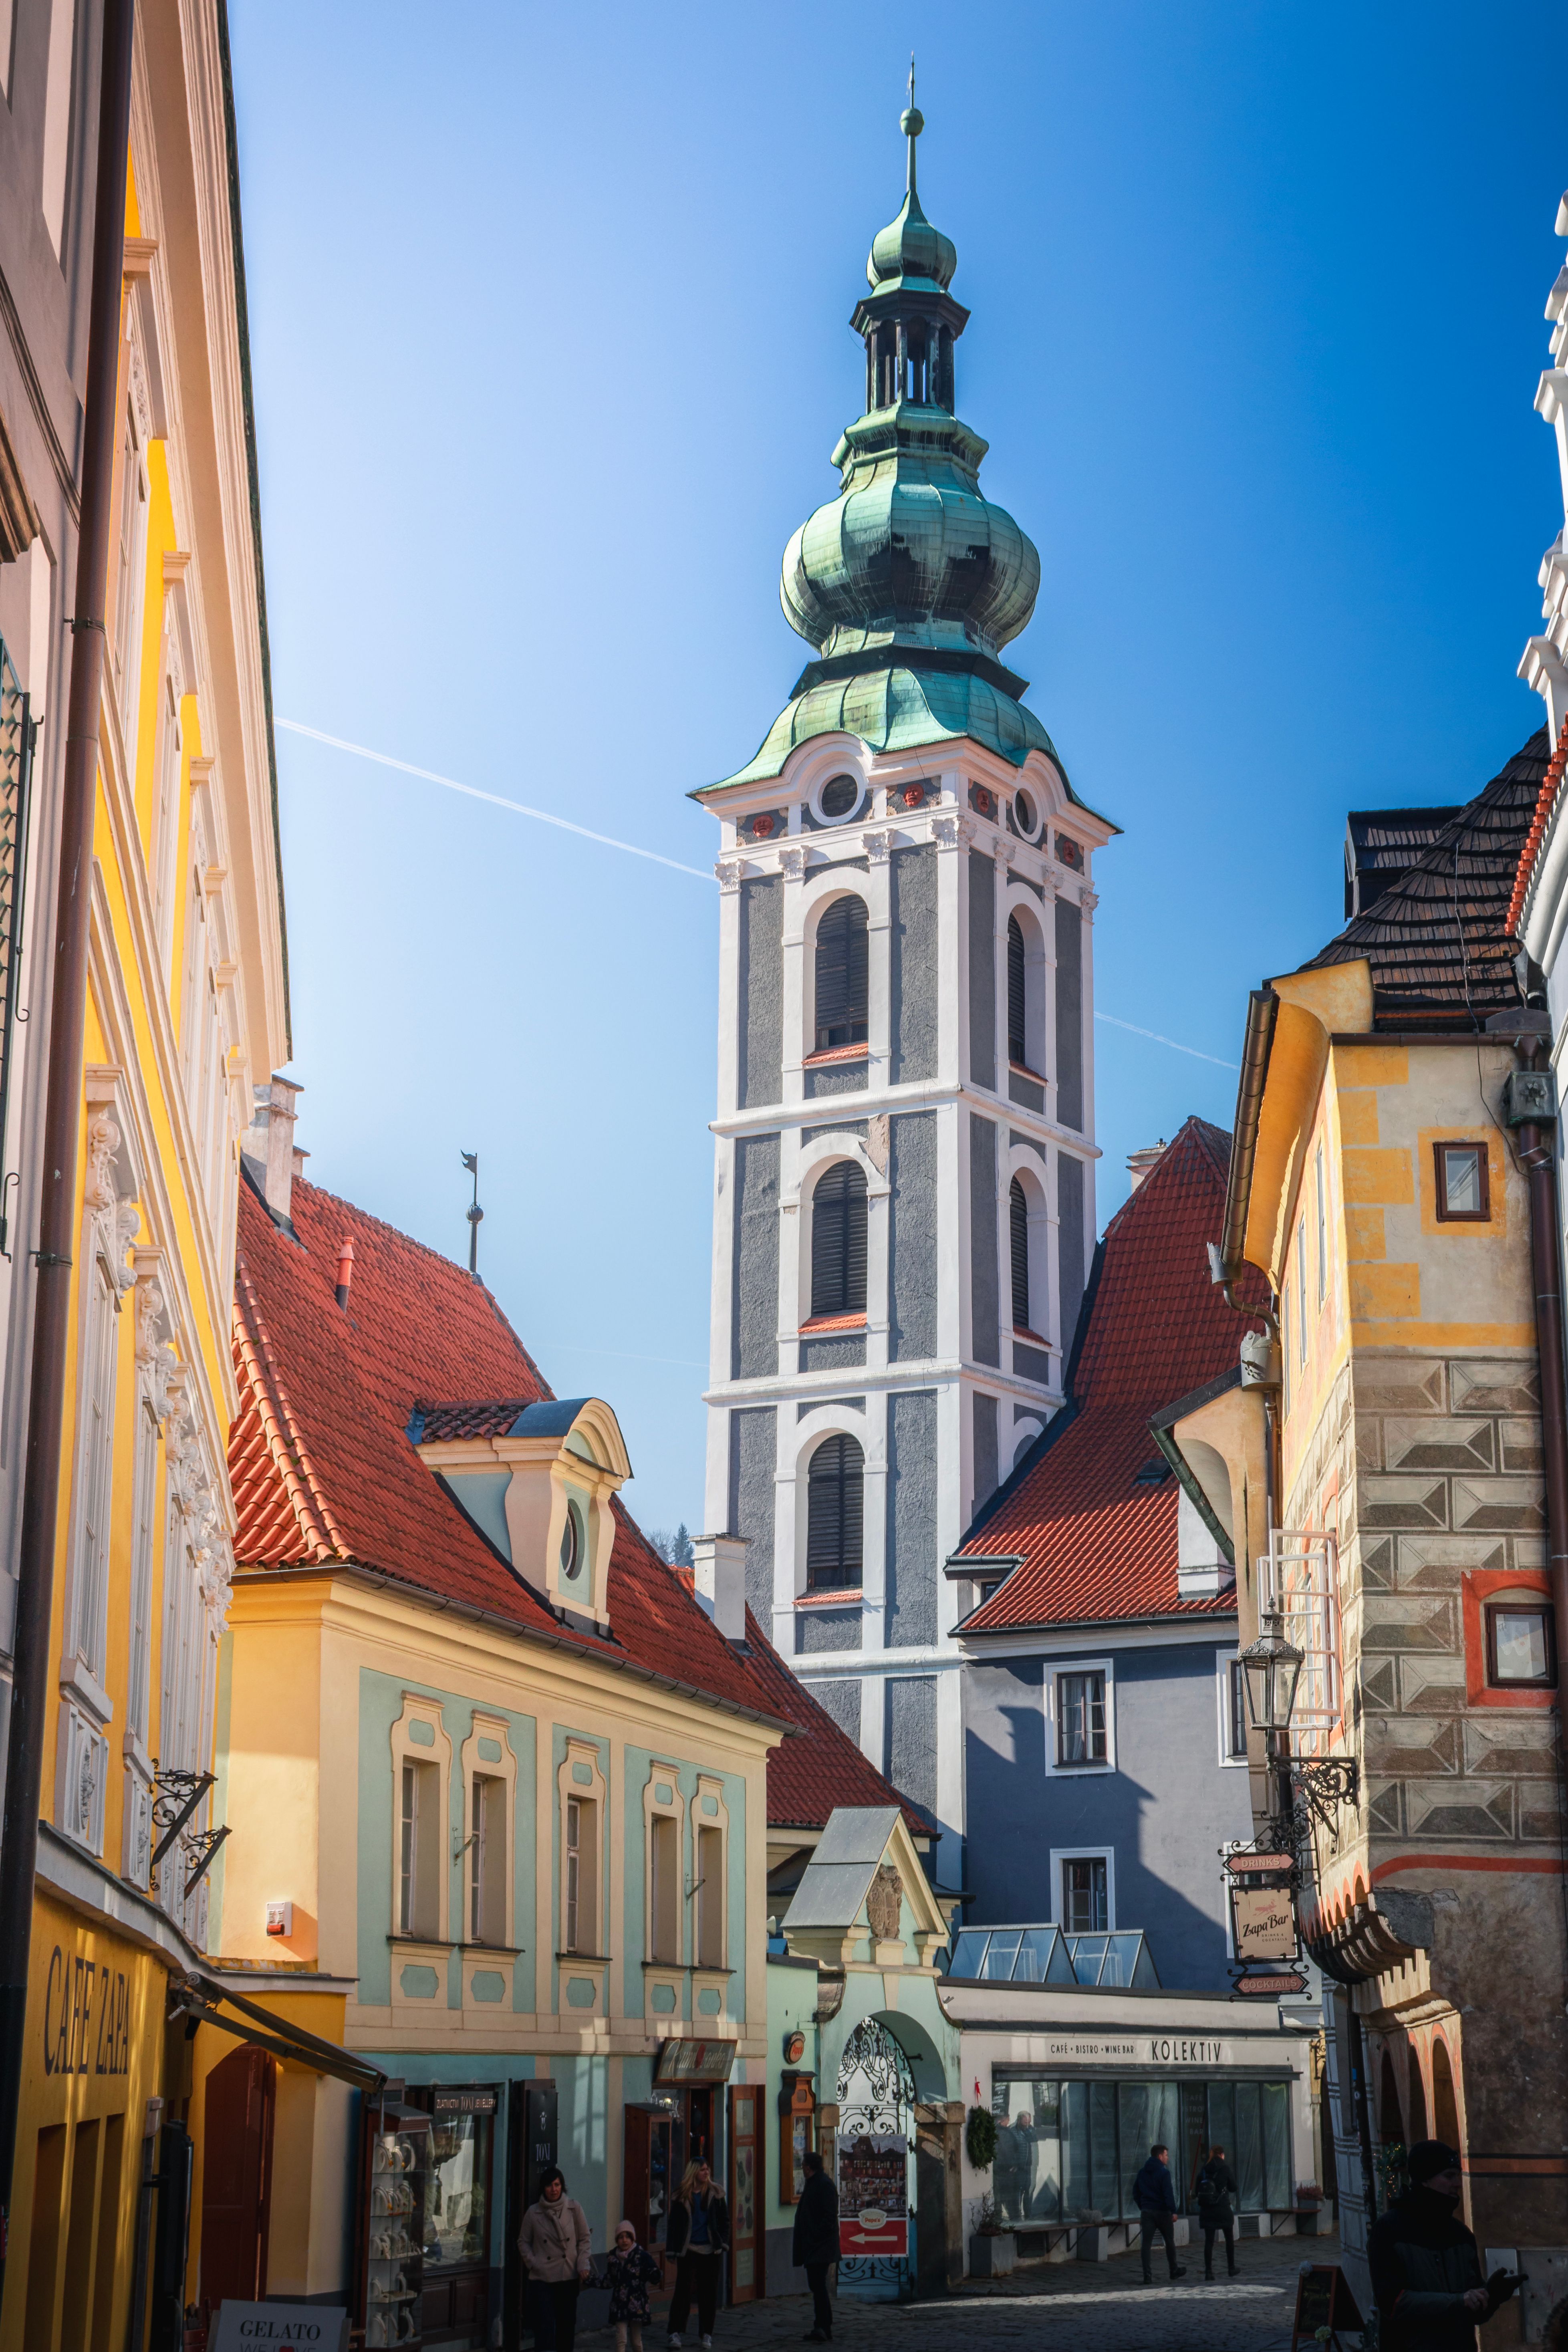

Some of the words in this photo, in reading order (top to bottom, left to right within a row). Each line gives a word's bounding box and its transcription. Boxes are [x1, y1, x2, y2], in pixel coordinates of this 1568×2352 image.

[1241, 1857, 1281, 1868] DRINKS
[1243, 1922, 1268, 1938] Zapa
[1268, 1914, 1288, 1929] Bar
[1242, 1977, 1297, 1990] COCKTAILS
[44, 1945, 95, 2077] CAFE
[95, 1966, 130, 2075] ZAPA
[1051, 2042, 1068, 2054] CAFÉ
[1076, 2045, 1098, 2054] BISTRO
[1105, 2045, 1121, 2054] WINE
[1123, 2045, 1134, 2054] BAR
[1152, 2040, 1221, 2061] KOLEKTIV
[460, 2096, 474, 2110] TONI
[536, 2143, 550, 2161] TONI
[240, 2320, 321, 2341] GELATO
